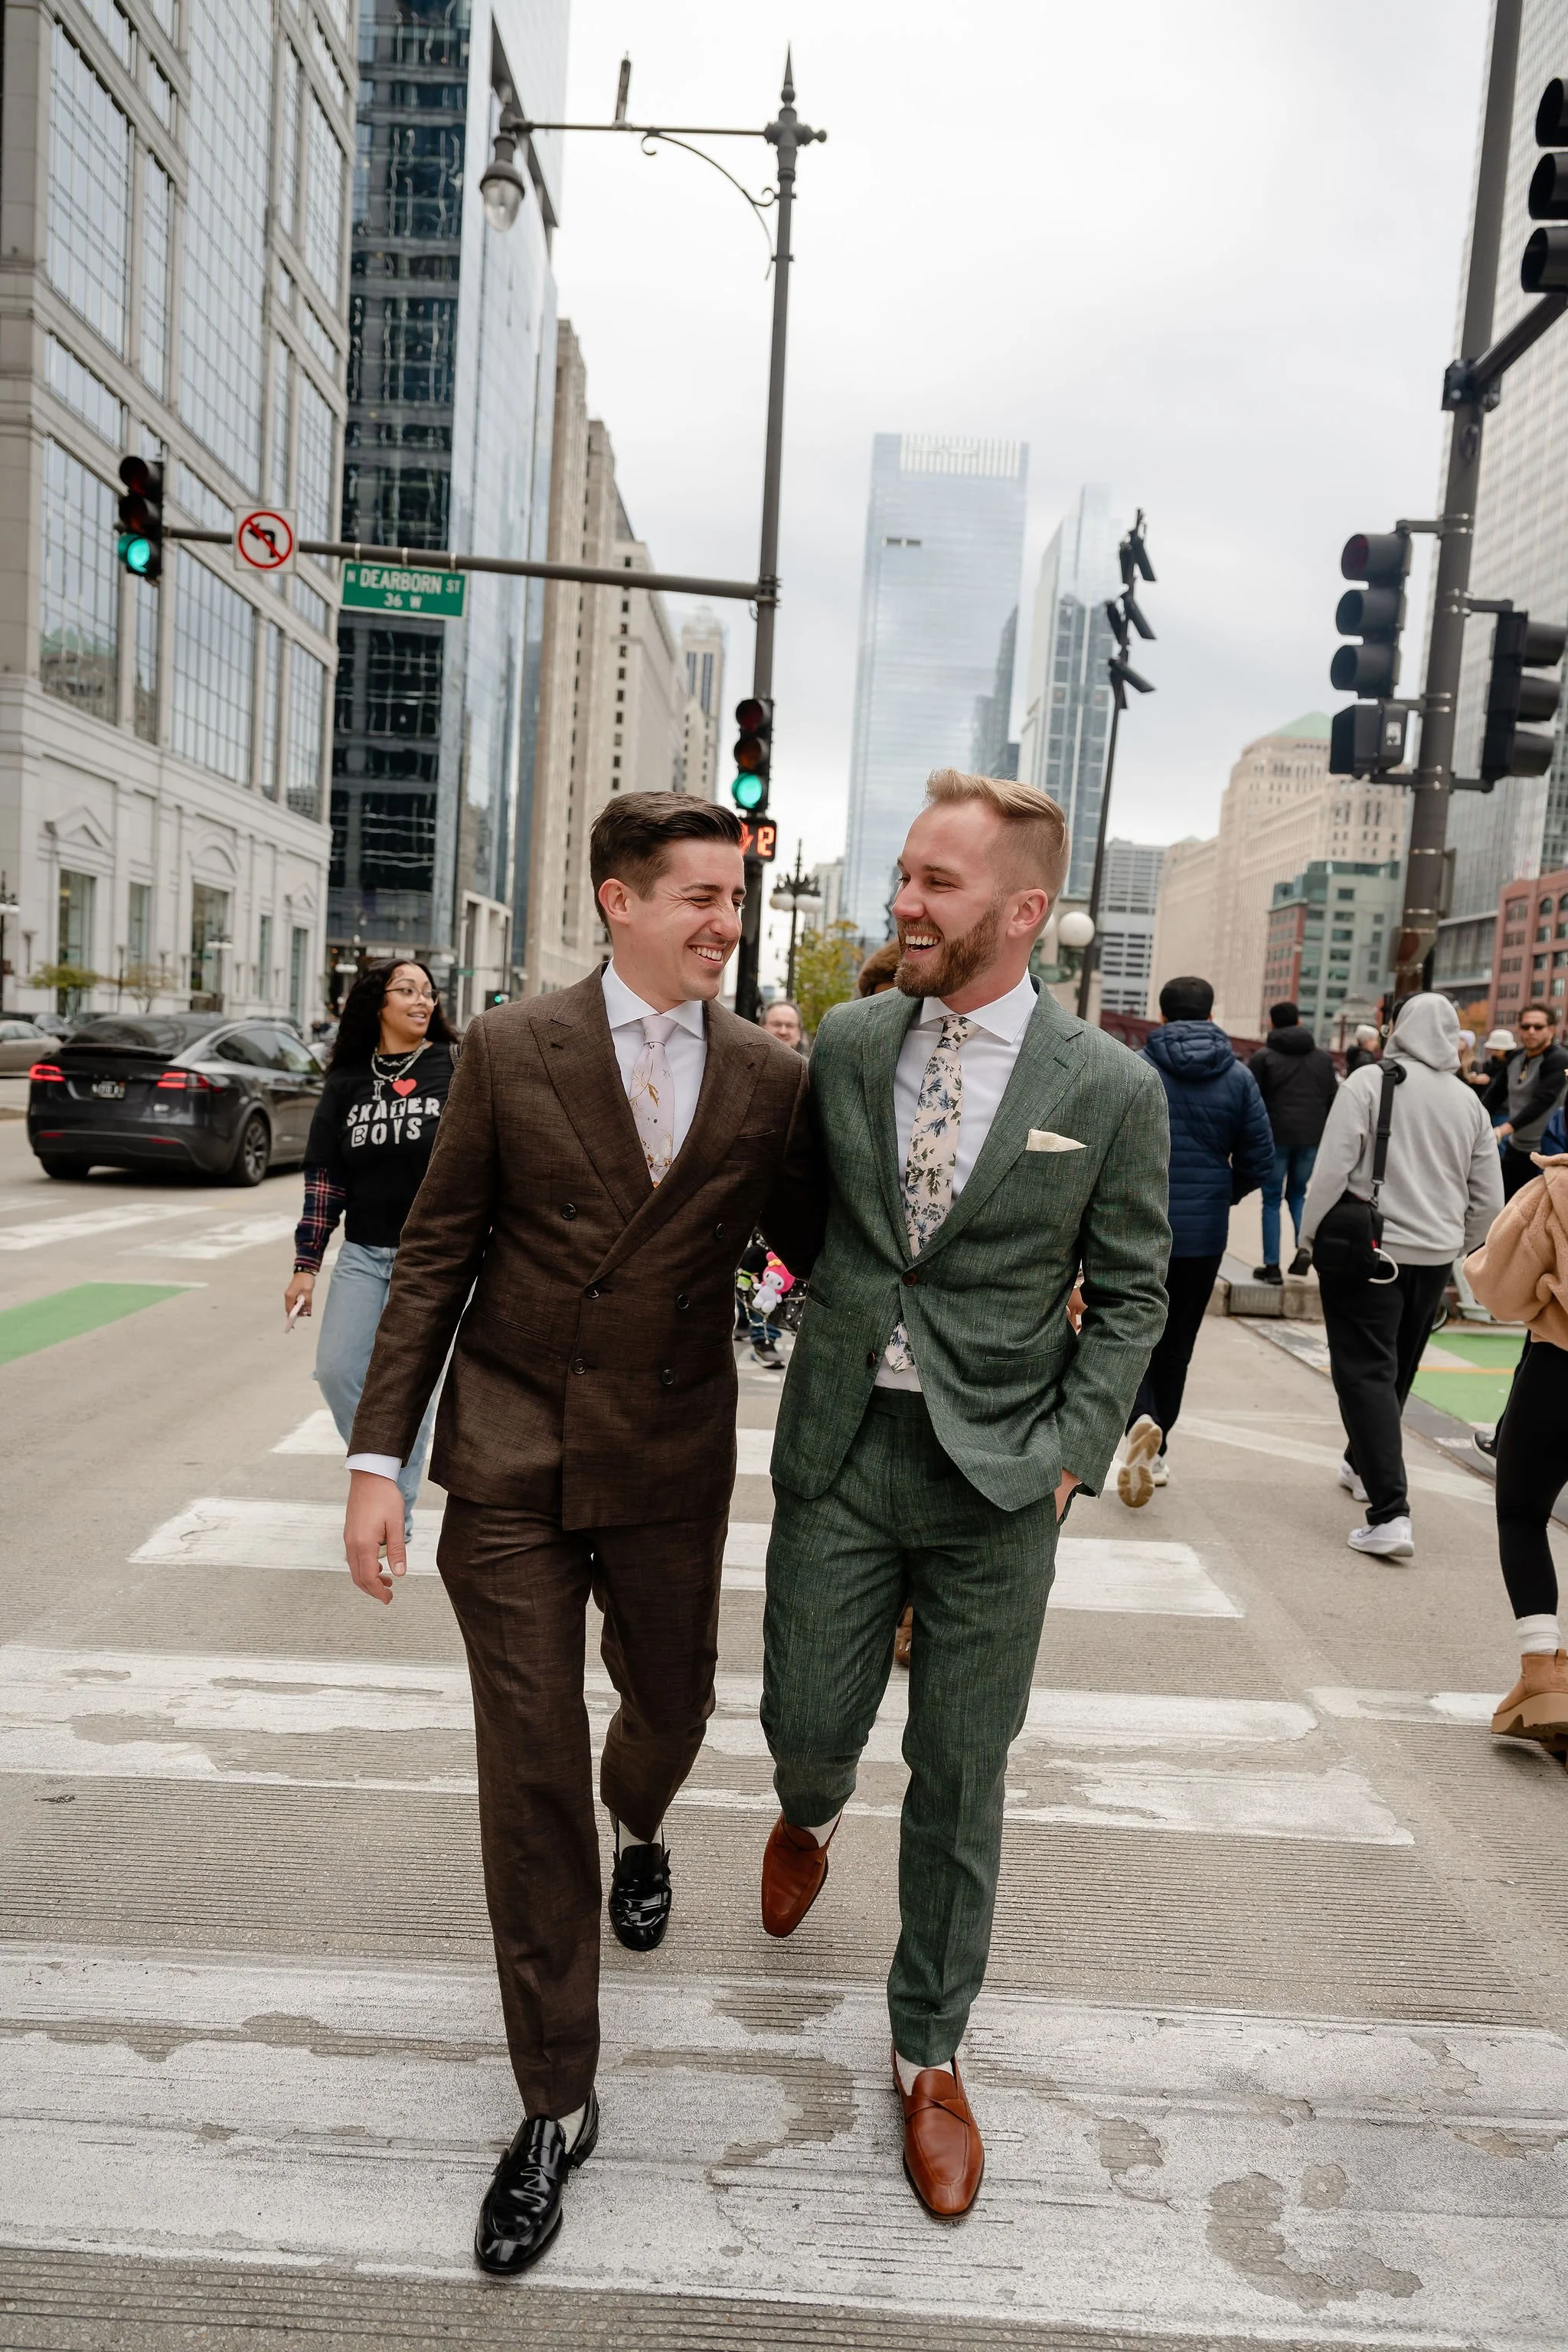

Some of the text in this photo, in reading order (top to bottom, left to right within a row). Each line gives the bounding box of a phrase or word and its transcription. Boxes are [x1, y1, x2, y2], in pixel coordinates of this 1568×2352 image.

[346, 567, 461, 595] N DEARBORN ST
[384, 592, 422, 609] 36 W
[372, 1080, 386, 1101] I
[346, 1096, 441, 1128] SKATER
[351, 1117, 423, 1148] BOYS
